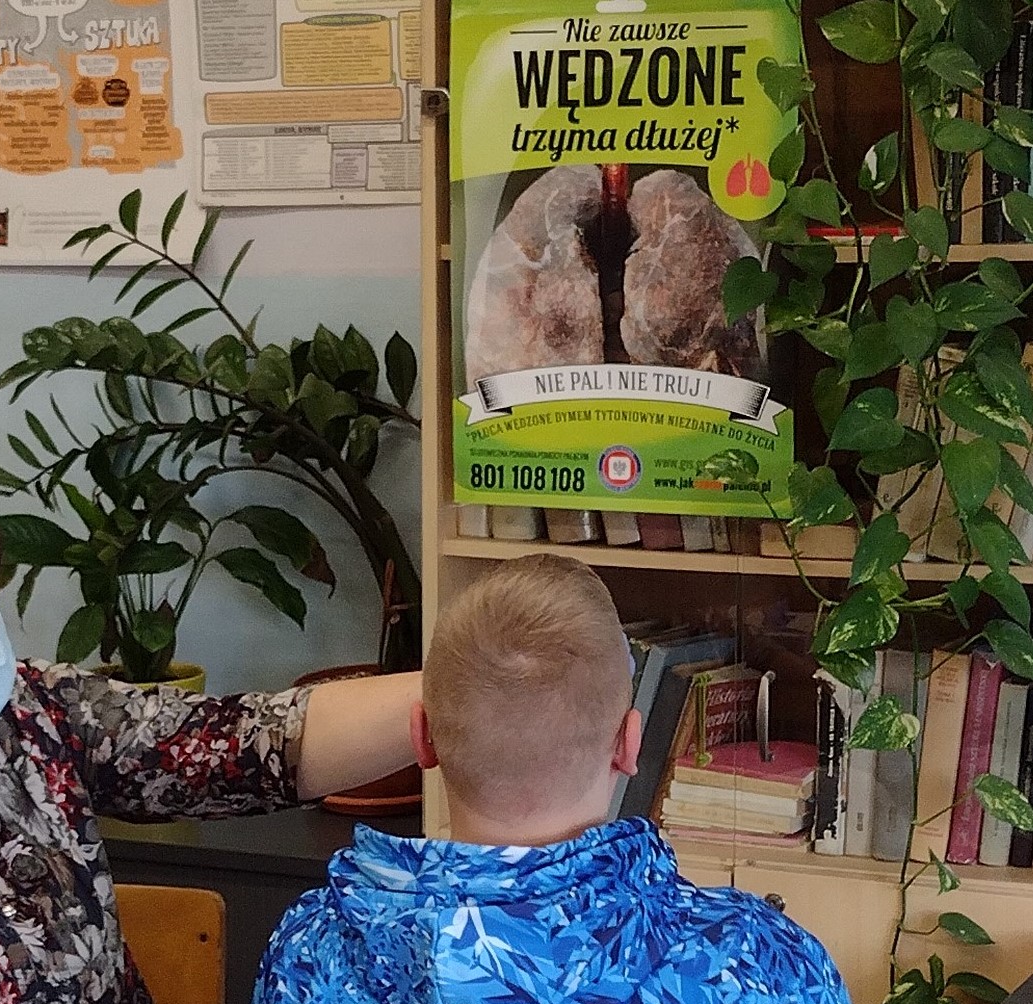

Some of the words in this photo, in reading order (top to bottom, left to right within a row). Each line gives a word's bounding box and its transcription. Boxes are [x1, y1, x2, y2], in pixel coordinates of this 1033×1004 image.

[84, 17, 160, 50] SZTUKA
[563, 18, 601, 43] Nie
[608, 22, 691, 42] zawsze
[513, 45, 746, 124] WĘDZONE
[512, 122, 617, 162] trzyma
[535, 372, 566, 395] NIE
[570, 371, 603, 391] PAL
[618, 371, 648, 391] NIE
[652, 373, 701, 398] TRUJ
[555, 410, 592, 424] DYMEM
[594, 409, 664, 426] TYTONIOWYM
[668, 412, 725, 437] NIEZDATNE
[728, 426, 743, 441] DO
[471, 463, 504, 489] 801
[512, 465, 546, 491] 108
[551, 467, 585, 492] 108
